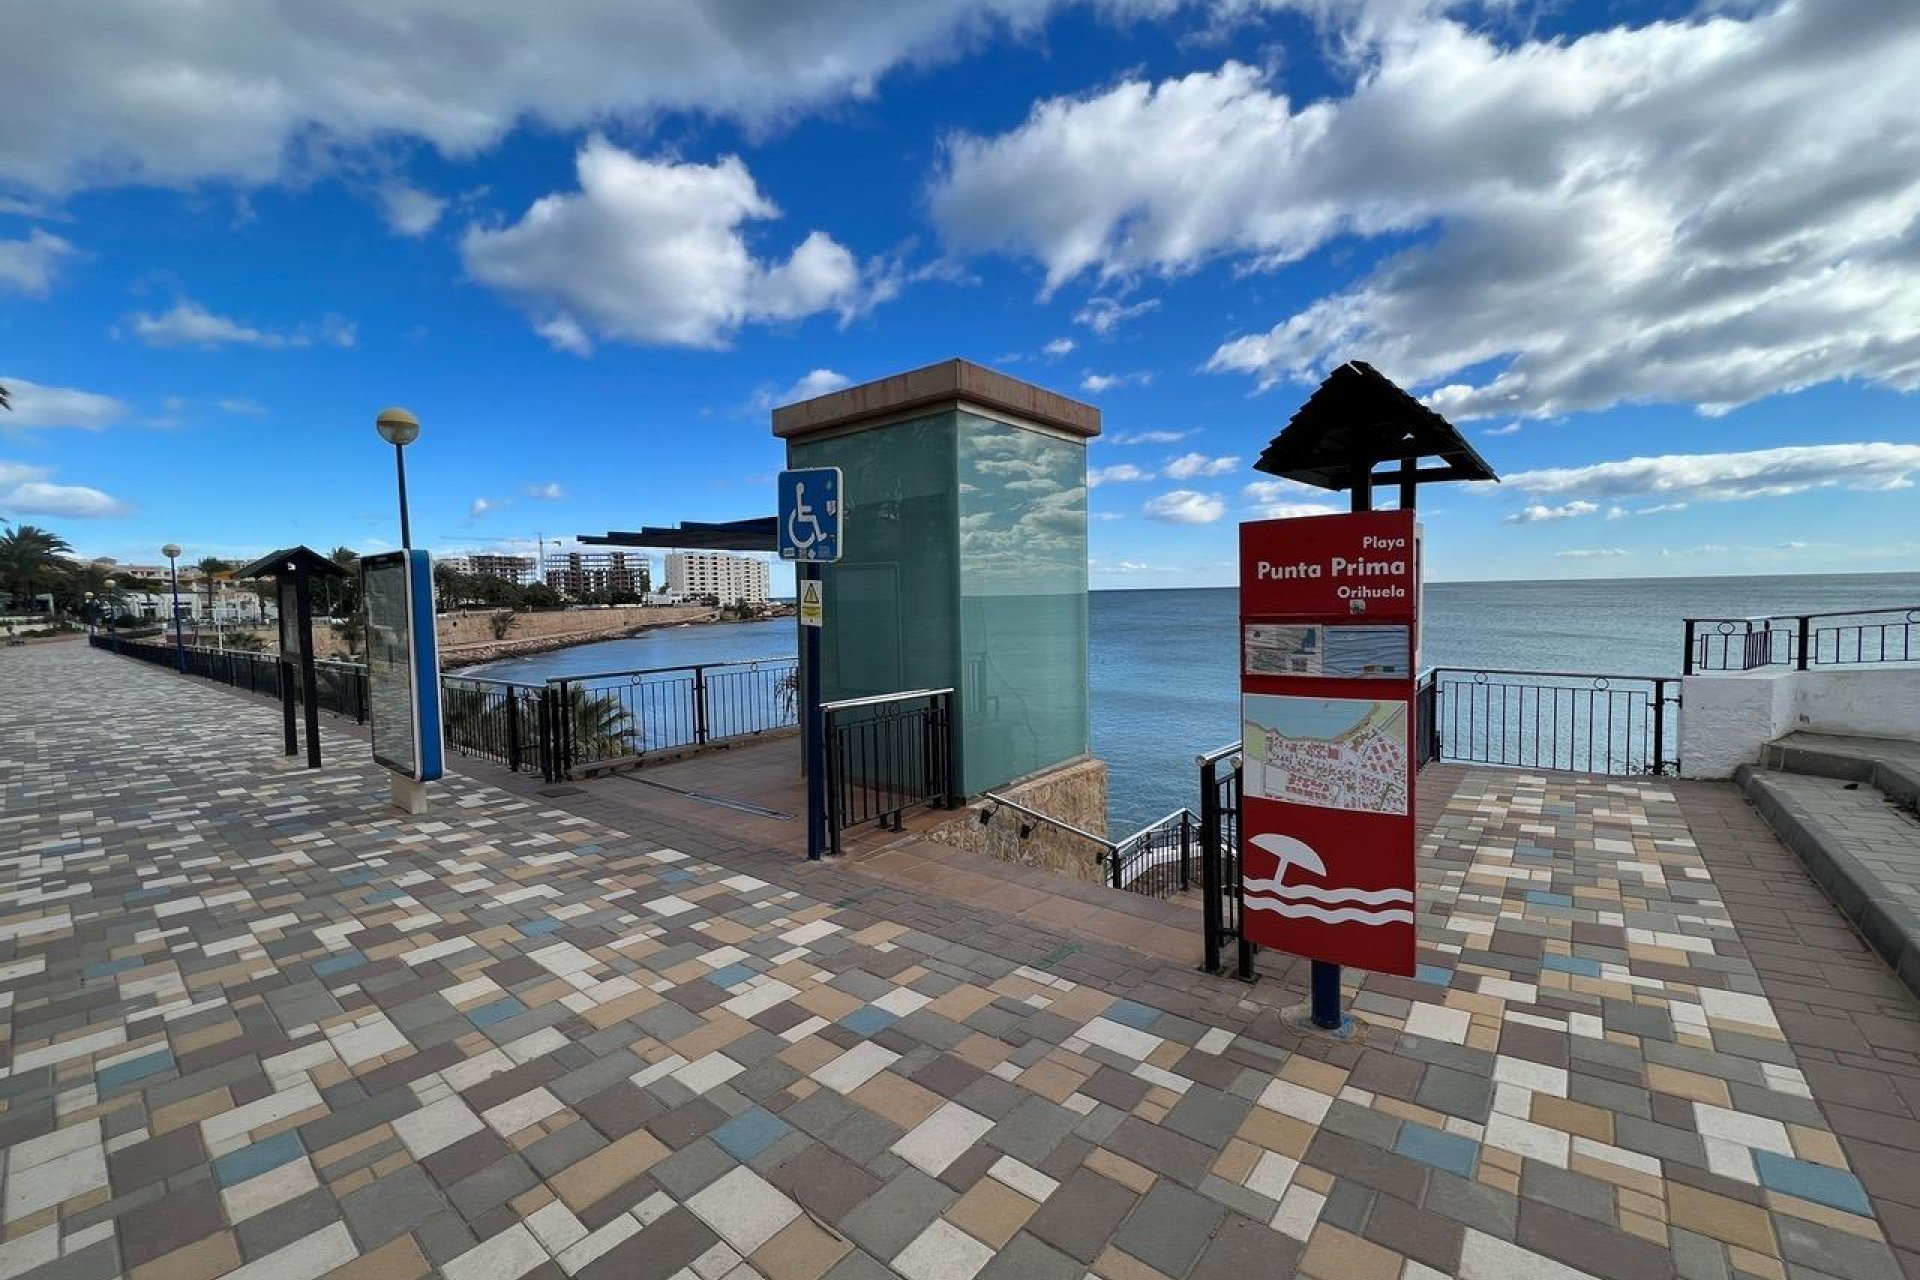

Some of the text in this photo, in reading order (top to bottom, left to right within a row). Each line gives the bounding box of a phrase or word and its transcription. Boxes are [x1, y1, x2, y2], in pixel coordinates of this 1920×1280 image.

[1363, 536, 1405, 550] Playa
[1257, 557, 1405, 580] Punta Prima
[1337, 585, 1405, 599] Orihuela
